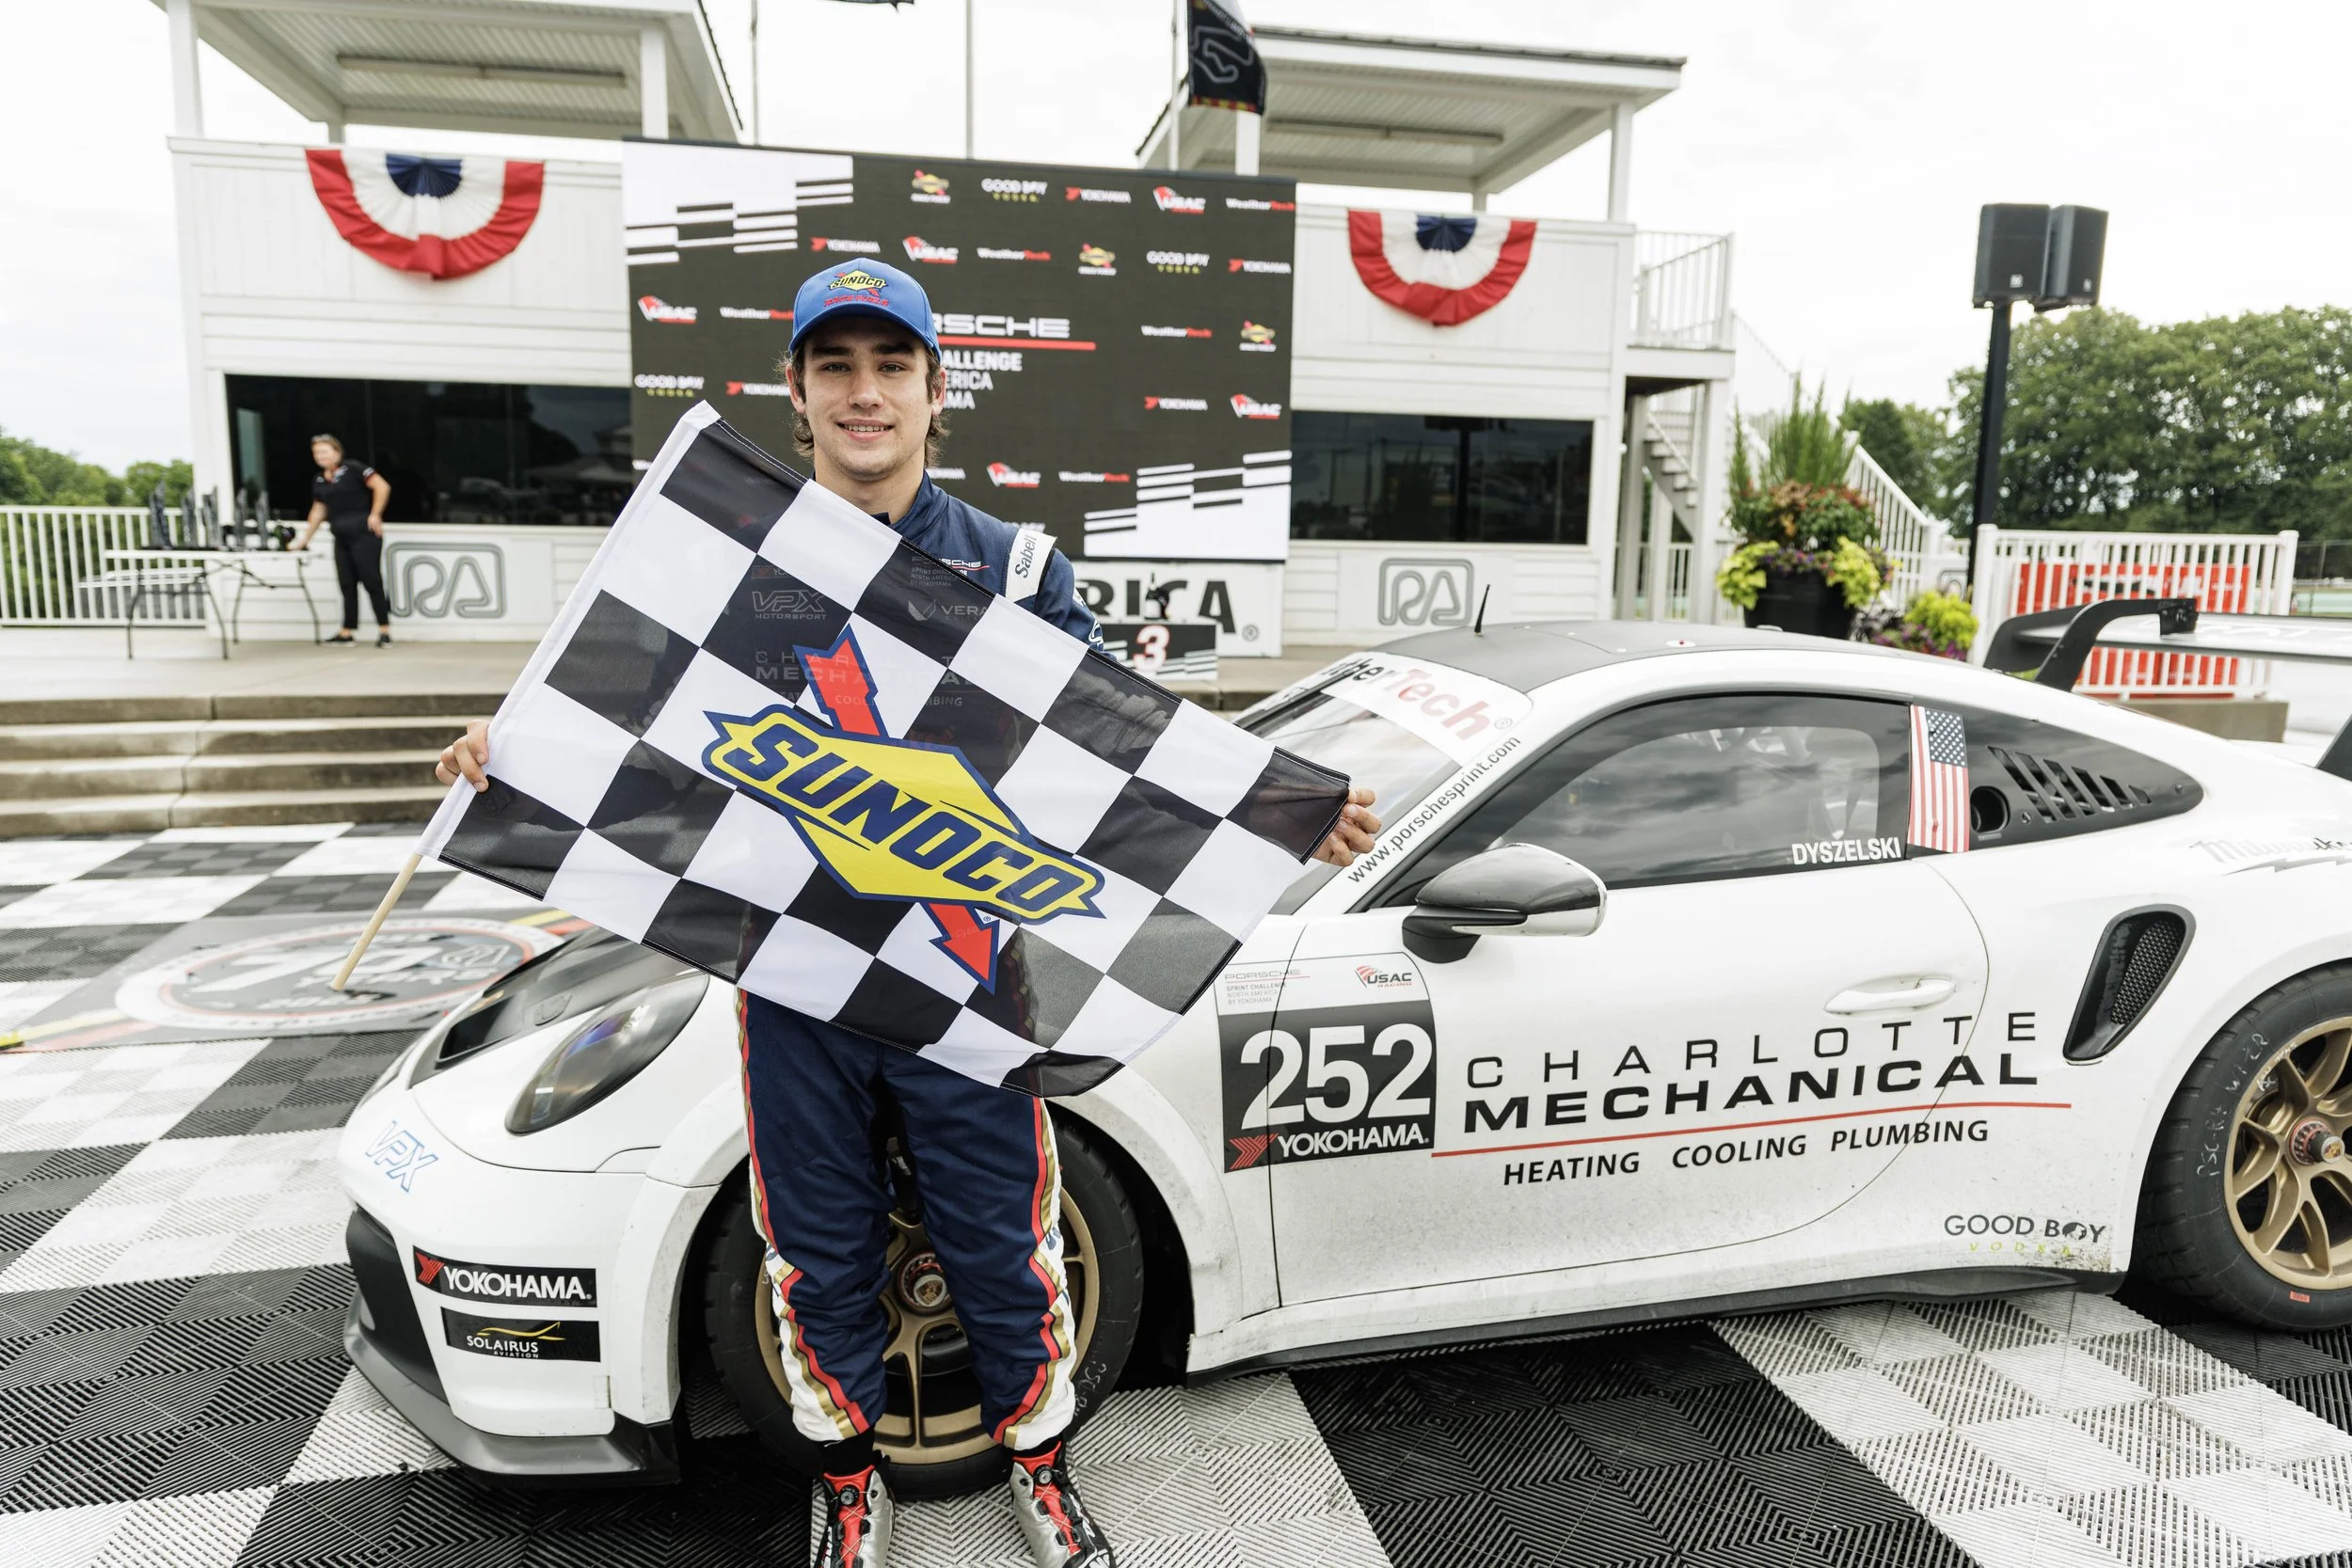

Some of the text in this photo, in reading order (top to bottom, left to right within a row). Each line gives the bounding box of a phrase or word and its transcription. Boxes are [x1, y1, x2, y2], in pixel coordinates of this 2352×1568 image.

[832, 274, 884, 288] SUNOCO
[855, 294, 889, 307] FUELS
[933, 313, 1071, 339] SCHE
[942, 349, 1023, 372] ALLENGE
[1015, 534, 1038, 578] Sabelt
[1133, 625, 1170, 673] 3
[722, 723, 1086, 910] SUNOCO
[1347, 735, 1521, 883] www.porschesprint.com
[1791, 836, 1902, 865] DYSZELSKI
[1224, 969, 1300, 979] PORSCHE
[1367, 973, 1412, 984] USAC
[1467, 1012, 2036, 1088] CHARLOTTE
[1240, 1022, 1433, 1131] 252
[1464, 1053, 2038, 1133] MECHANICAL
[365, 1119, 438, 1193] VPX
[1277, 1122, 1425, 1158] YOKOHAMA
[1503, 1119, 1988, 1185] HEATING COOLING PLUMBING
[1944, 1214, 2035, 1236] GOOD
[443, 1265, 587, 1300] YOKOHAMA
[466, 1335, 539, 1354] SOLAIRUS
[493, 1351, 539, 1359] AVIATION
